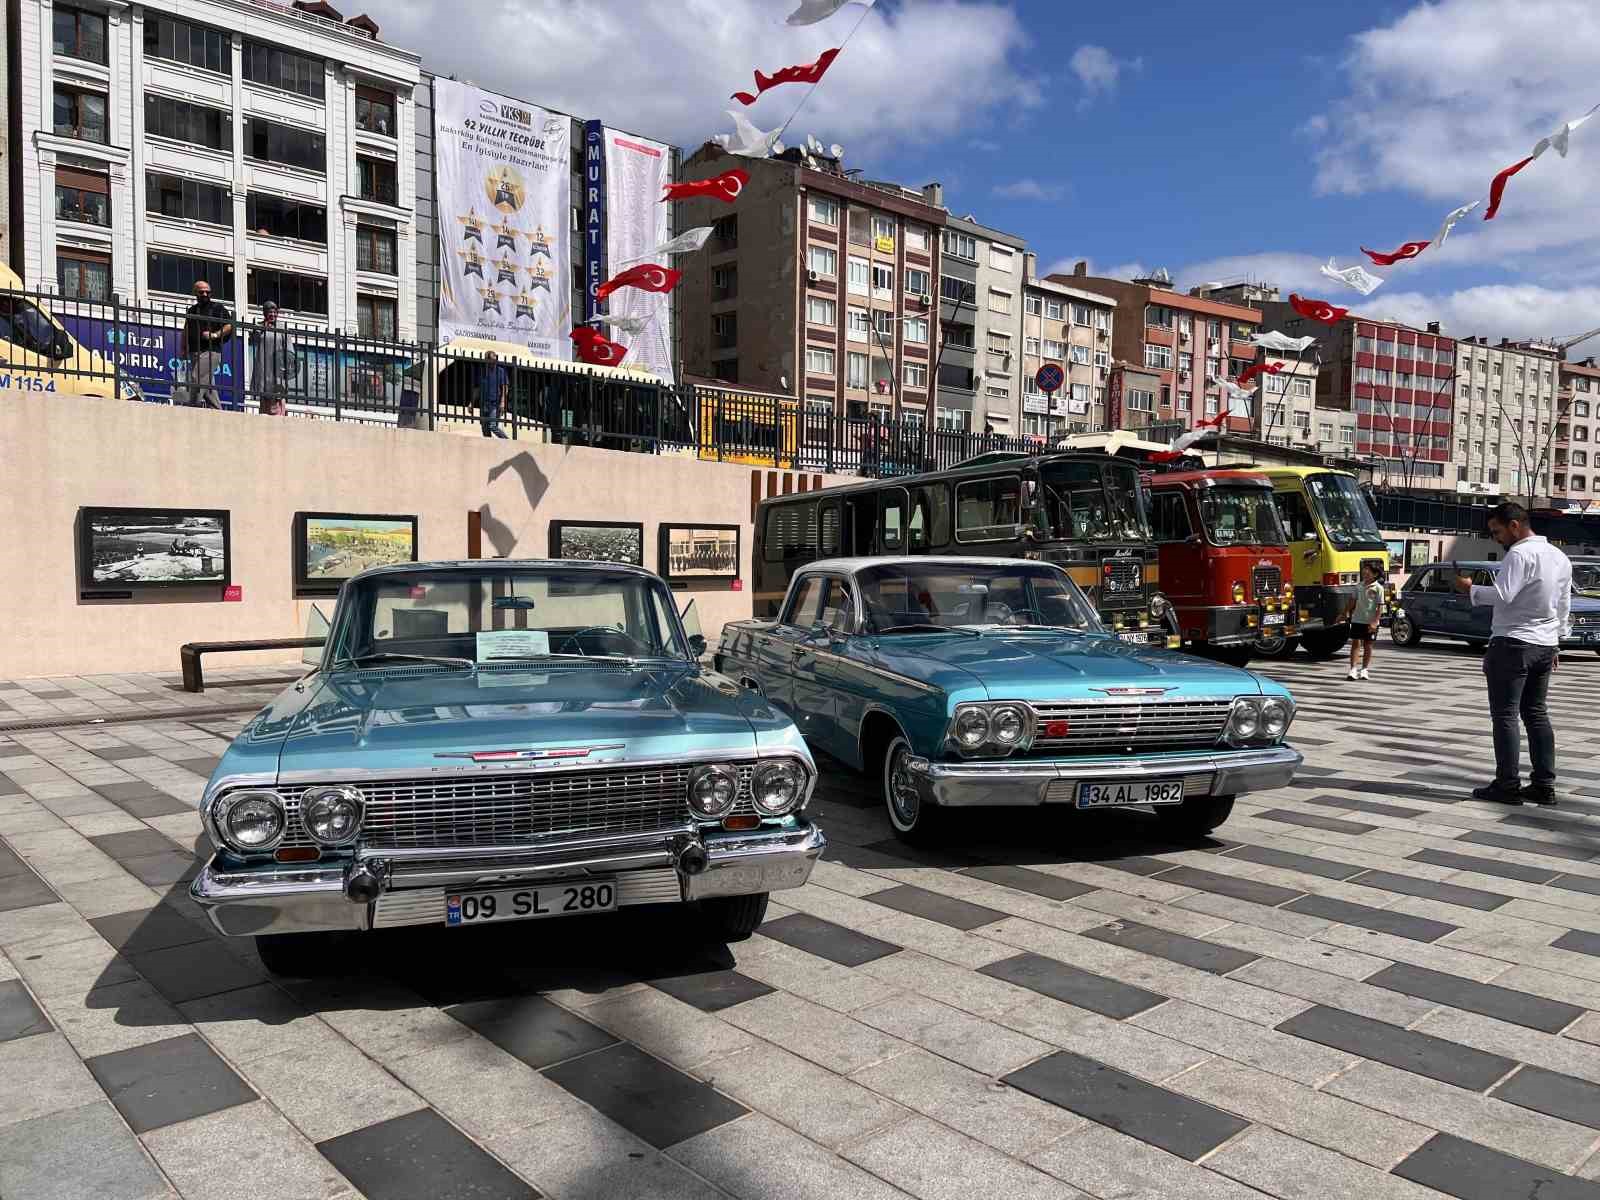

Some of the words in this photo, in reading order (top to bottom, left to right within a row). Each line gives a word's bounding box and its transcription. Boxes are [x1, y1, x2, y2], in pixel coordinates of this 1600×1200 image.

[464, 119, 477, 130] 42
[479, 122, 507, 139] YILLIK
[509, 131, 545, 150] TECRÜBE
[588, 145, 600, 244] MURAT
[15, 375, 56, 392] 1154
[1090, 786, 1110, 803] 34
[1114, 785, 1138, 802] AL
[1145, 783, 1180, 801] 1962
[462, 895, 497, 919] 09
[512, 891, 549, 915] SL
[563, 885, 613, 911] 280
